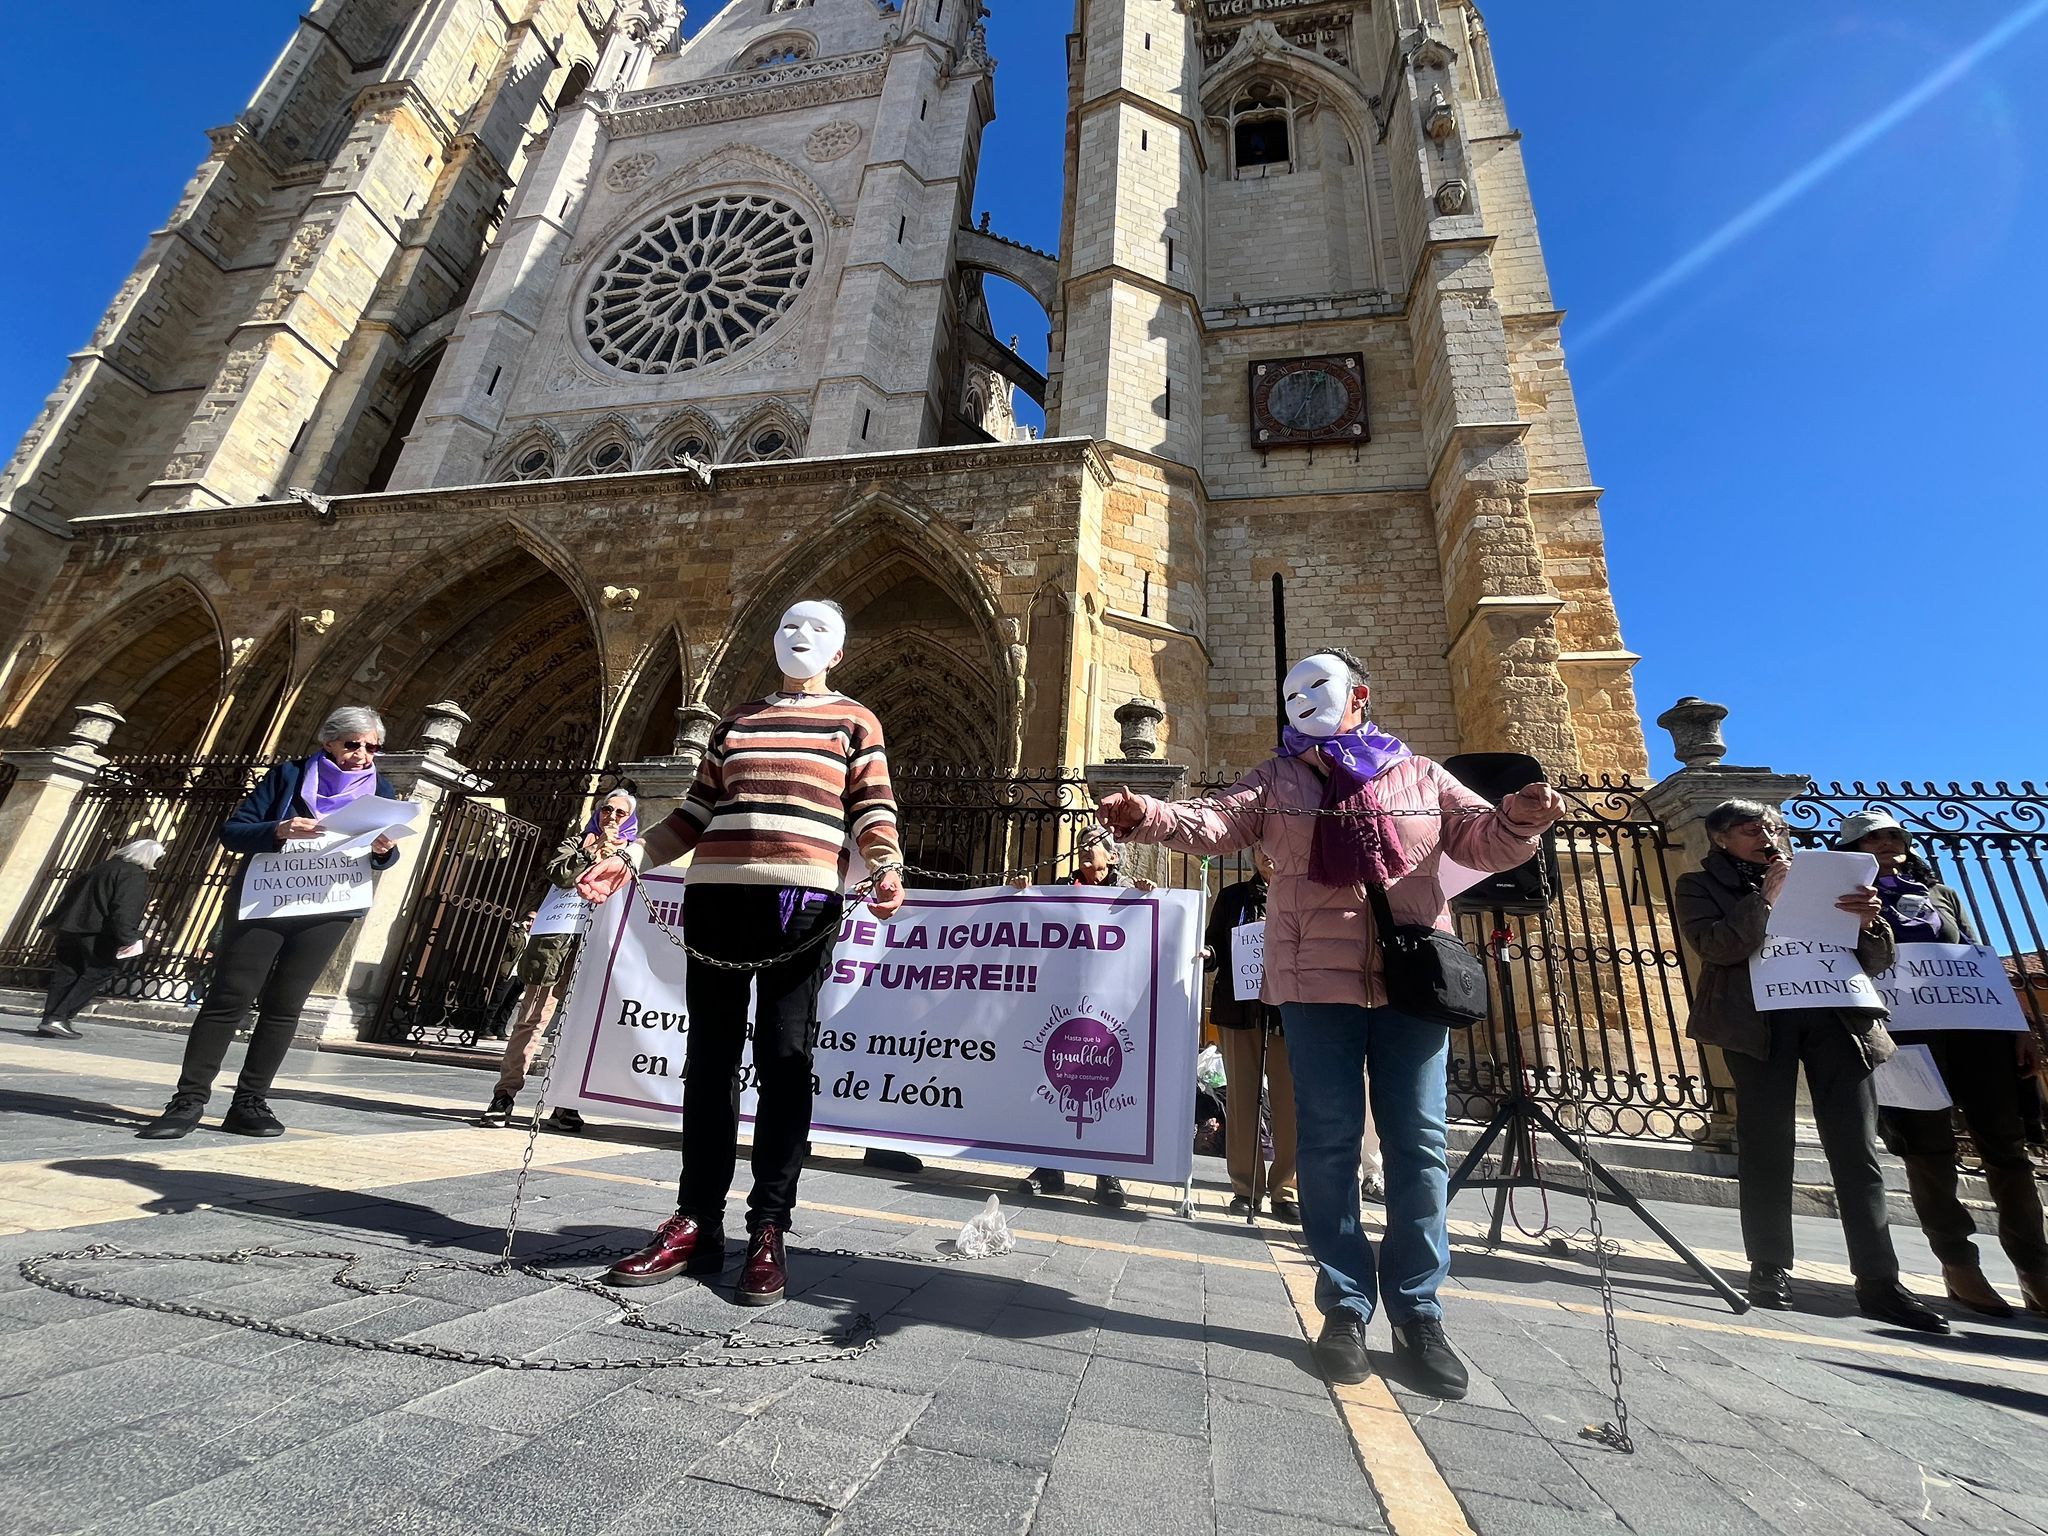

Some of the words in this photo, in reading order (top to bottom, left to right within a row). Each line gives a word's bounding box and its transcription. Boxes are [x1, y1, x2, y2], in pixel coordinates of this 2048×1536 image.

[264, 860, 280, 873] LA
[284, 857, 337, 872] IGLESIA
[340, 856, 359, 868] SEA
[253, 877, 283, 891] UNA
[286, 871, 363, 889] COMUNIDAD
[273, 894, 293, 907] DE
[296, 889, 352, 906] IGUALES
[546, 913, 562, 921] LAS
[885, 924, 928, 950] LA
[937, 921, 1126, 951] IGUALDAD
[1818, 959, 1836, 973] Y
[1908, 959, 1985, 979] MUJER
[1911, 986, 2003, 1006] IGLESIA
[1022, 1003, 1072, 1053] Revuelta
[1078, 995, 1093, 1015] de
[1099, 1009, 1135, 1054] mujeres
[812, 1021, 856, 1052] las
[866, 1029, 996, 1064] mujeres
[1064, 1034, 1082, 1042] Hasta
[1082, 1036, 1094, 1044] que
[1051, 1044, 1116, 1071] igualdad
[632, 1053, 669, 1078] en
[833, 1070, 870, 1101] de
[879, 1073, 964, 1110] León
[1064, 1072, 1078, 1081] haga
[1079, 1074, 1110, 1082] costumbre
[1036, 1084, 1057, 1105] en
[1059, 1084, 1078, 1114] la
[1086, 1086, 1137, 1122] Iglesia
